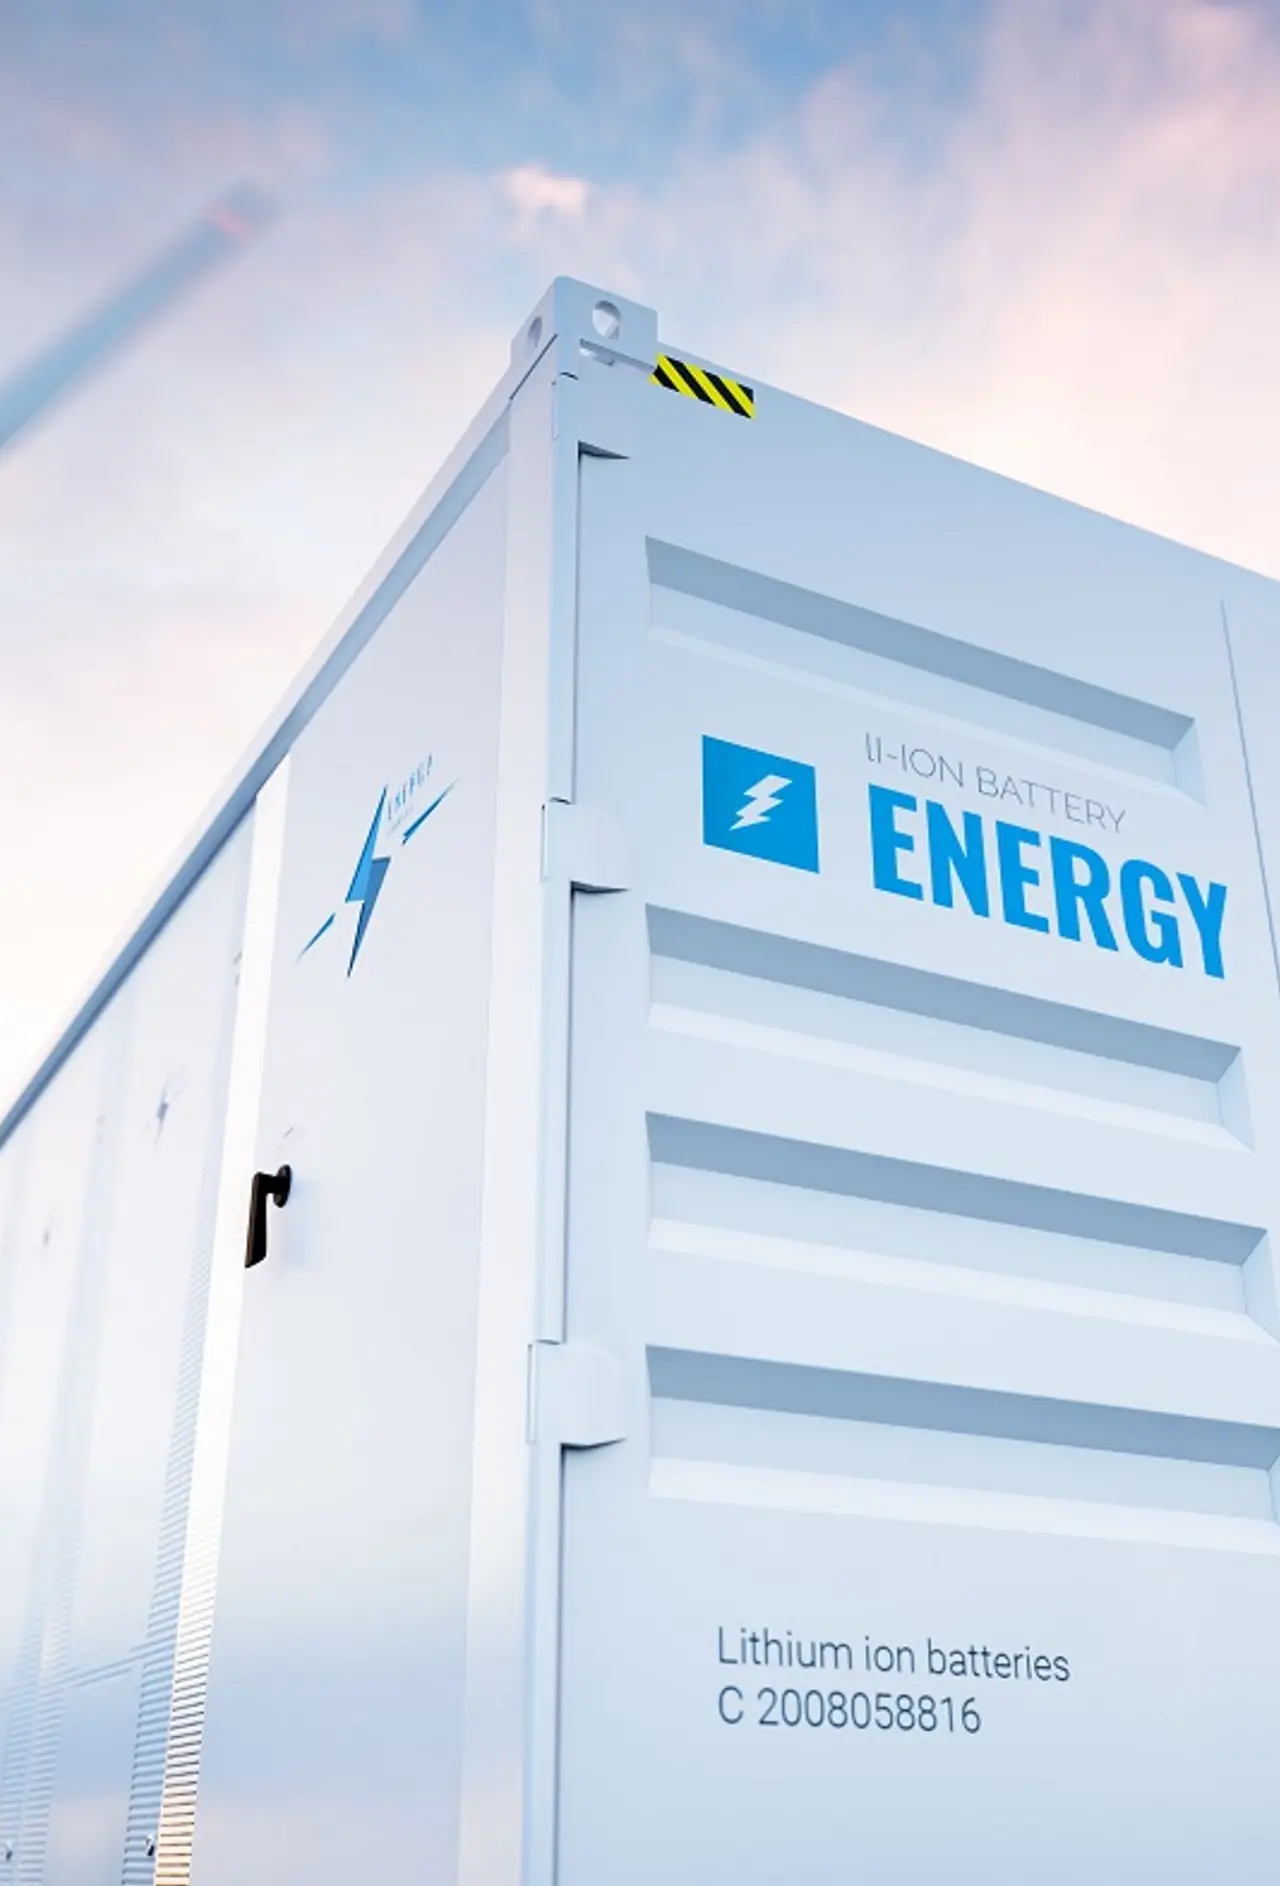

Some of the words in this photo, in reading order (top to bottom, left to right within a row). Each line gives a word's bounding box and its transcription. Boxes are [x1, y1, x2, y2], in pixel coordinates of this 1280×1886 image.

[975, 765, 1127, 833] BATTERY
[868, 783, 1227, 979] ENERGY
[718, 1626, 853, 1670] Lithium
[865, 1636, 915, 1673] ion
[927, 1638, 1071, 1682] batteries
[719, 1685, 744, 1724] C
[757, 1687, 982, 1734] 2008058816
